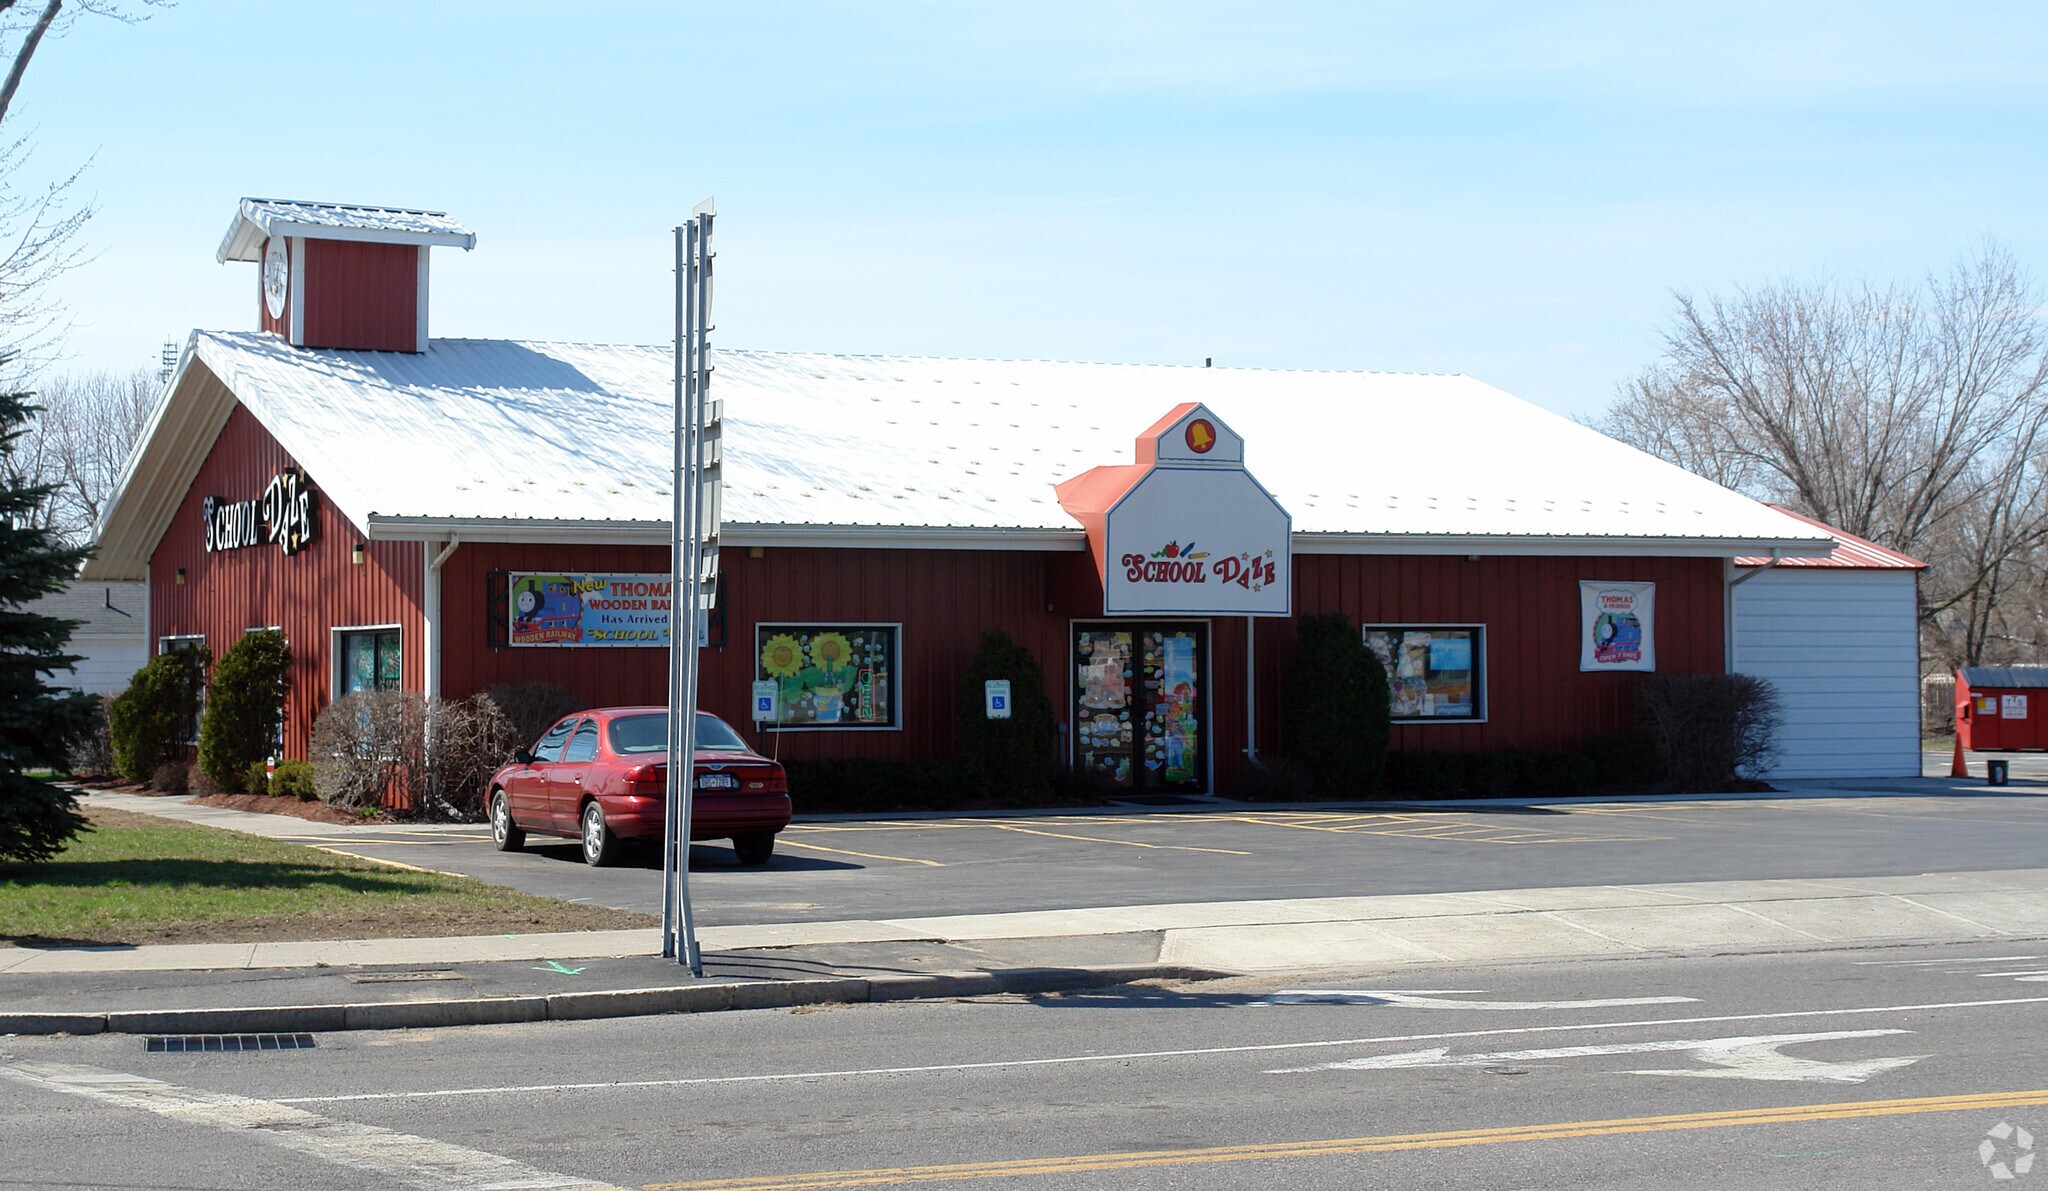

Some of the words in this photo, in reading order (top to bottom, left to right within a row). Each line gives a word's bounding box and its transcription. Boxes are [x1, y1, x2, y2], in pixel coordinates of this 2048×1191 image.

[573, 578, 607, 593] New
[611, 582, 672, 597] THOMA
[588, 599, 647, 611] WOODEN
[1601, 595, 1634, 603] THOMAS
[601, 615, 623, 624] Has
[627, 615, 668, 624] Arrived
[514, 633, 545, 643] WOODEN
[546, 629, 576, 641] RAILWAY
